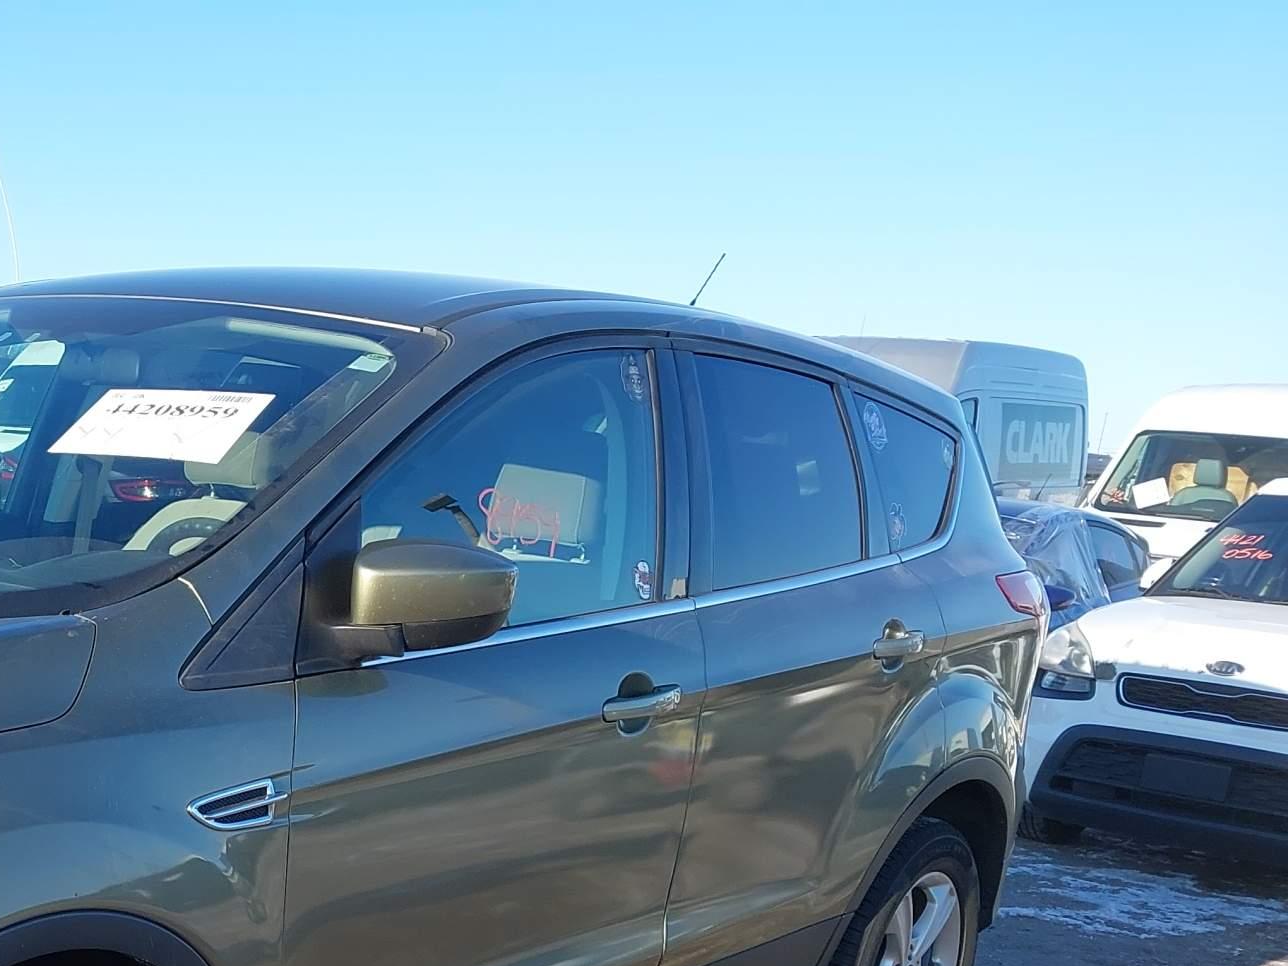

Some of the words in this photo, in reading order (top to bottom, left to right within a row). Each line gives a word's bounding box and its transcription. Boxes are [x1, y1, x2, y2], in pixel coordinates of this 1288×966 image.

[1007, 419, 1072, 465] CLARK
[1220, 534, 1264, 547] 4421
[1222, 548, 1273, 561] 0516
